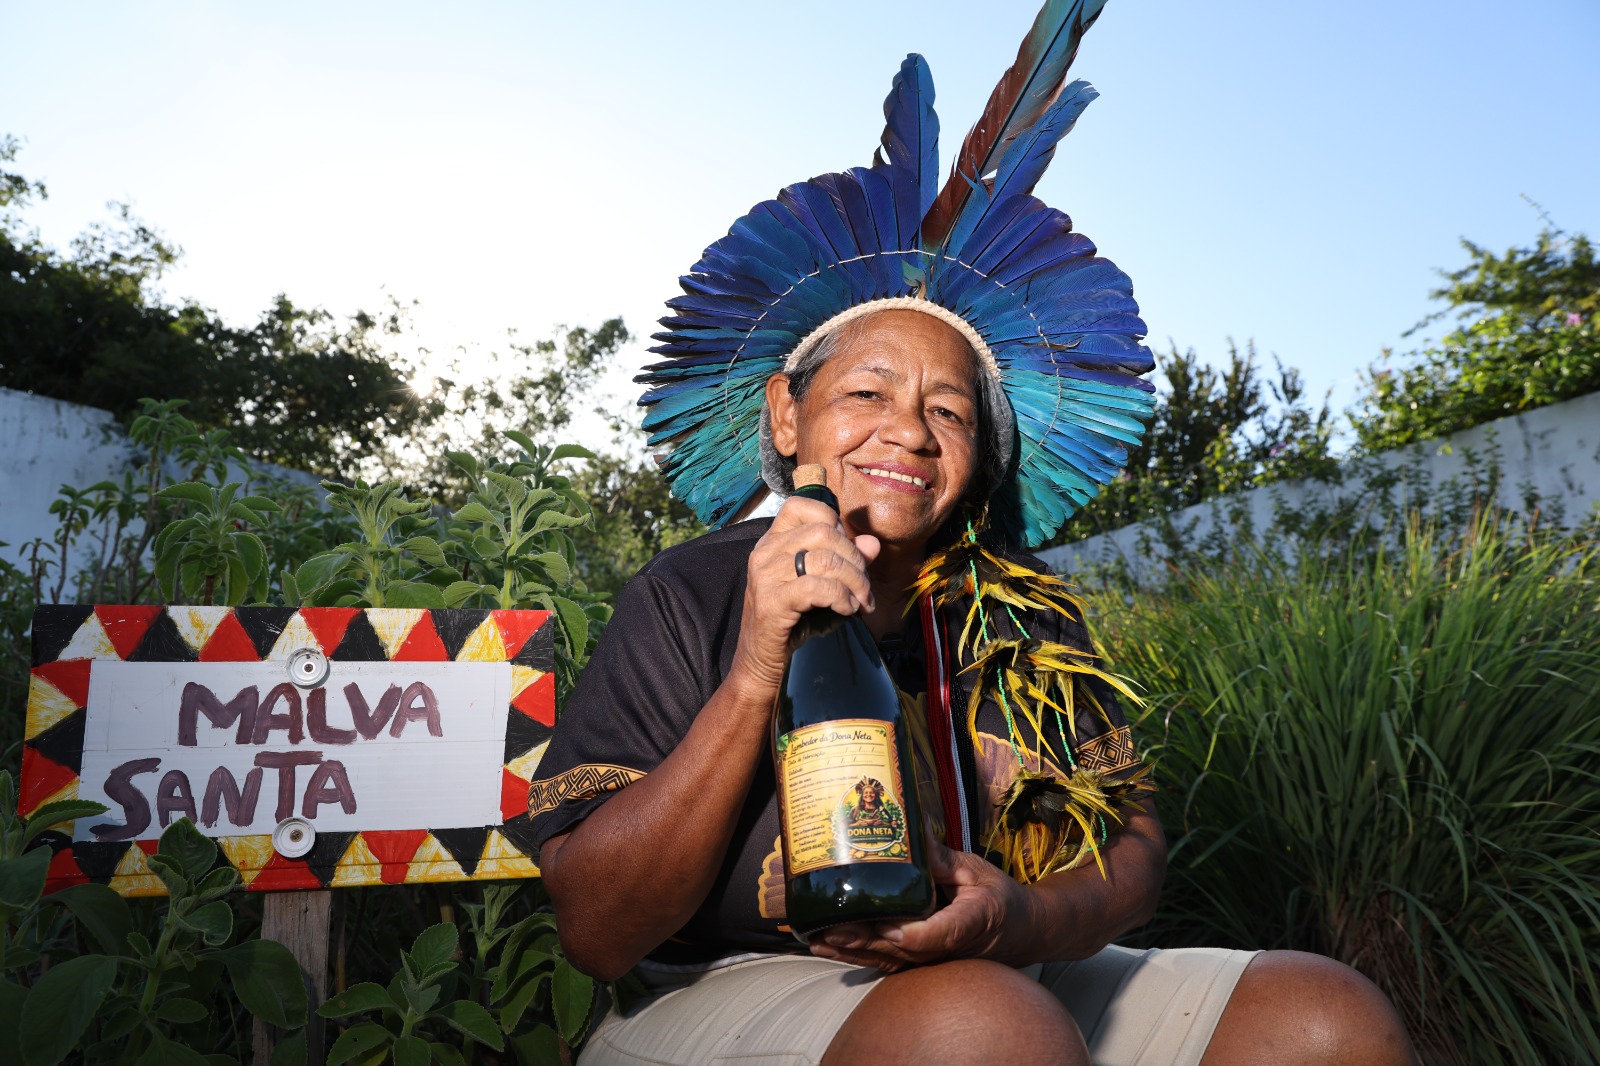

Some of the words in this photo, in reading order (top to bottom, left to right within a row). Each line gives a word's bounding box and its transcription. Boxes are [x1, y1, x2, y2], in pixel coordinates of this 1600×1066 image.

[178, 681, 443, 746] MALVA
[790, 737, 818, 755] Lambedor
[820, 733, 829, 743] da
[829, 731, 852, 743] Dona
[852, 730, 872, 741] Neta
[89, 750, 358, 842] SANTA
[847, 828, 872, 837] DONA
[873, 827, 893, 836] NETA
